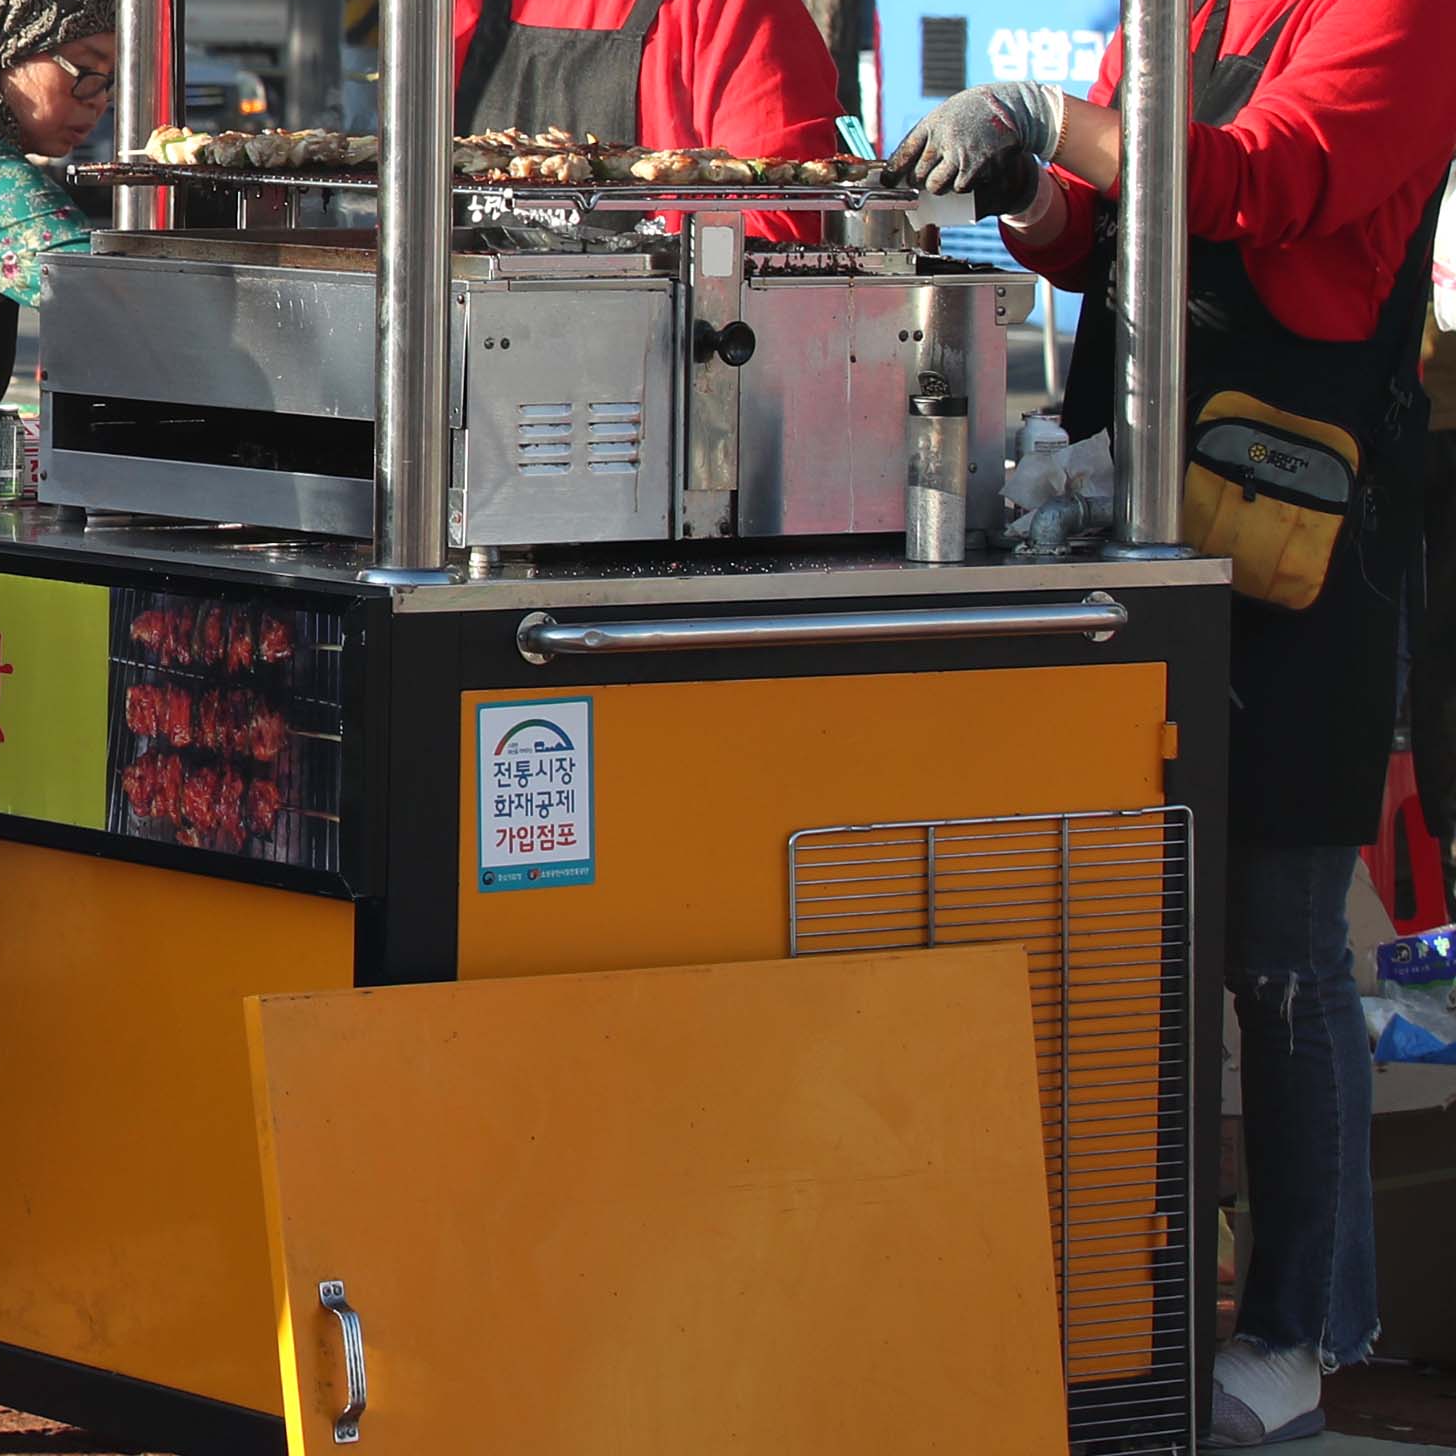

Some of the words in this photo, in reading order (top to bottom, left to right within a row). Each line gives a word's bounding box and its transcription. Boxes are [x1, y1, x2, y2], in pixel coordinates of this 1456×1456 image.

[989, 28, 1114, 81] 삼환교
[493, 757, 576, 788] 전통시장
[493, 789, 576, 819] 화재공제
[495, 823, 577, 854] 가입점포
